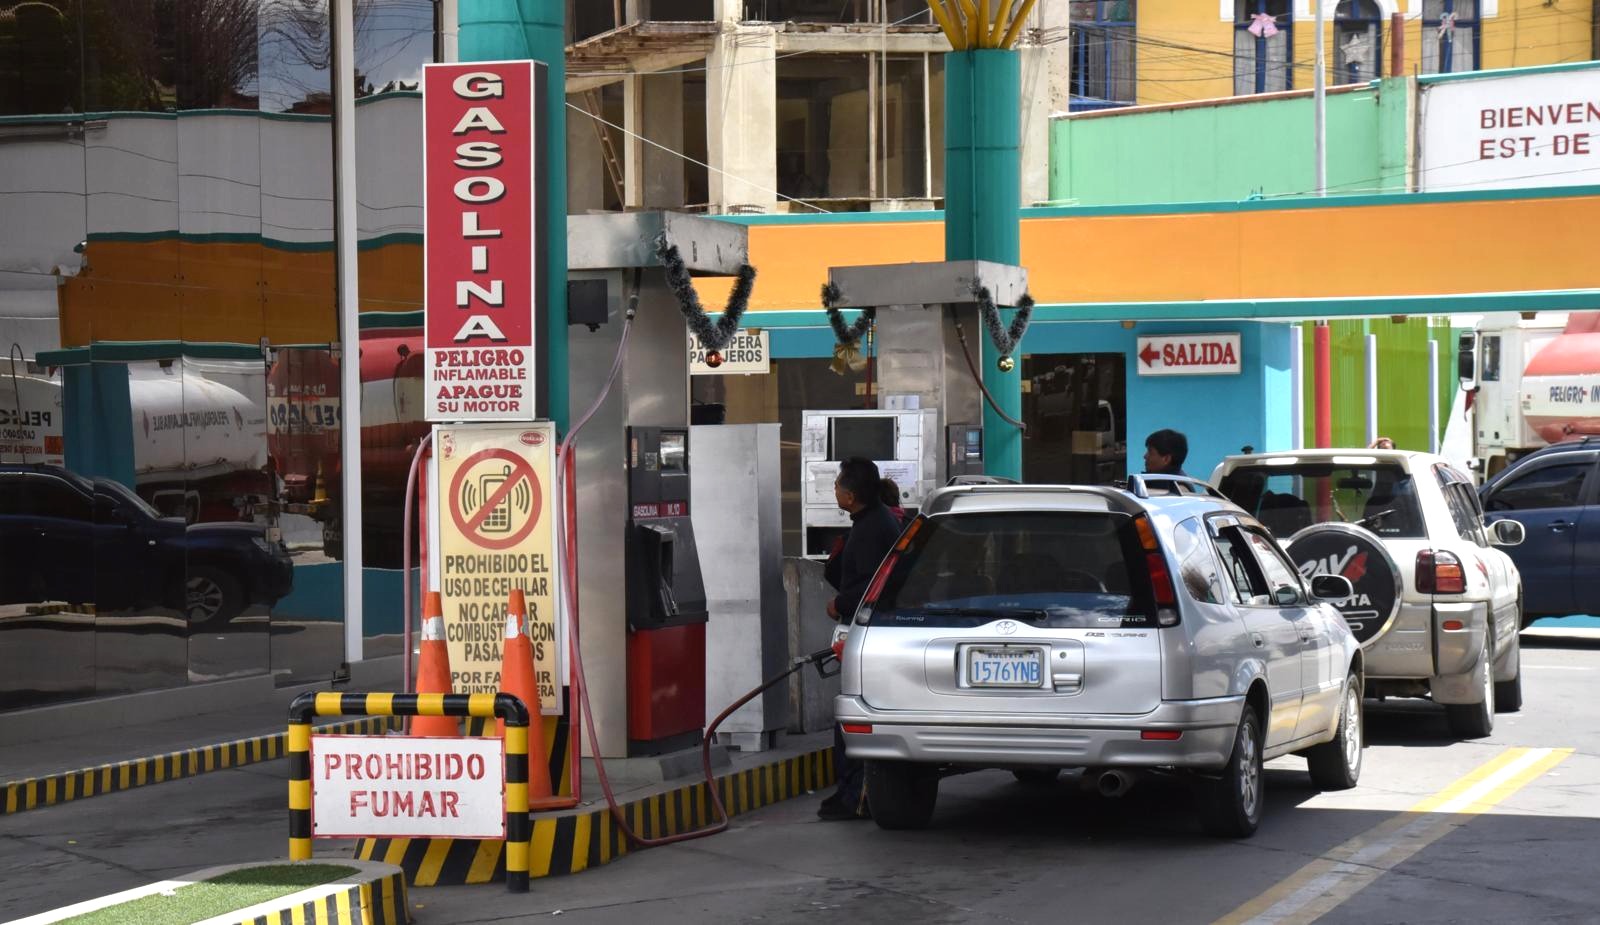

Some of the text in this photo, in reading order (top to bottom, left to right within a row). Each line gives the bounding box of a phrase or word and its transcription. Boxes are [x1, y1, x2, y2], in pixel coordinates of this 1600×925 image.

[1480, 101, 1600, 130] BIENVEN
[1480, 133, 1590, 160] EST. DE
[452, 72, 506, 342] GASOLINA
[435, 349, 524, 367] PELIGRO
[690, 350, 762, 363] PAJEROS
[1163, 342, 1237, 366] SALIDA
[434, 368, 526, 381] INFLAMABLE
[437, 385, 522, 399] APAGUE
[438, 401, 519, 413] SU MOTOR
[633, 503, 658, 517] GASOLINA
[445, 554, 549, 574] PROHIBIDO EL
[445, 578, 471, 597] USO
[474, 577, 490, 596] DE
[459, 603, 479, 622] NO
[532, 622, 555, 641] CON
[451, 671, 481, 684] POR
[974, 661, 1040, 682] 1576YNB
[324, 753, 486, 780] PROHIBIDO
[350, 790, 460, 818] FUMAR
